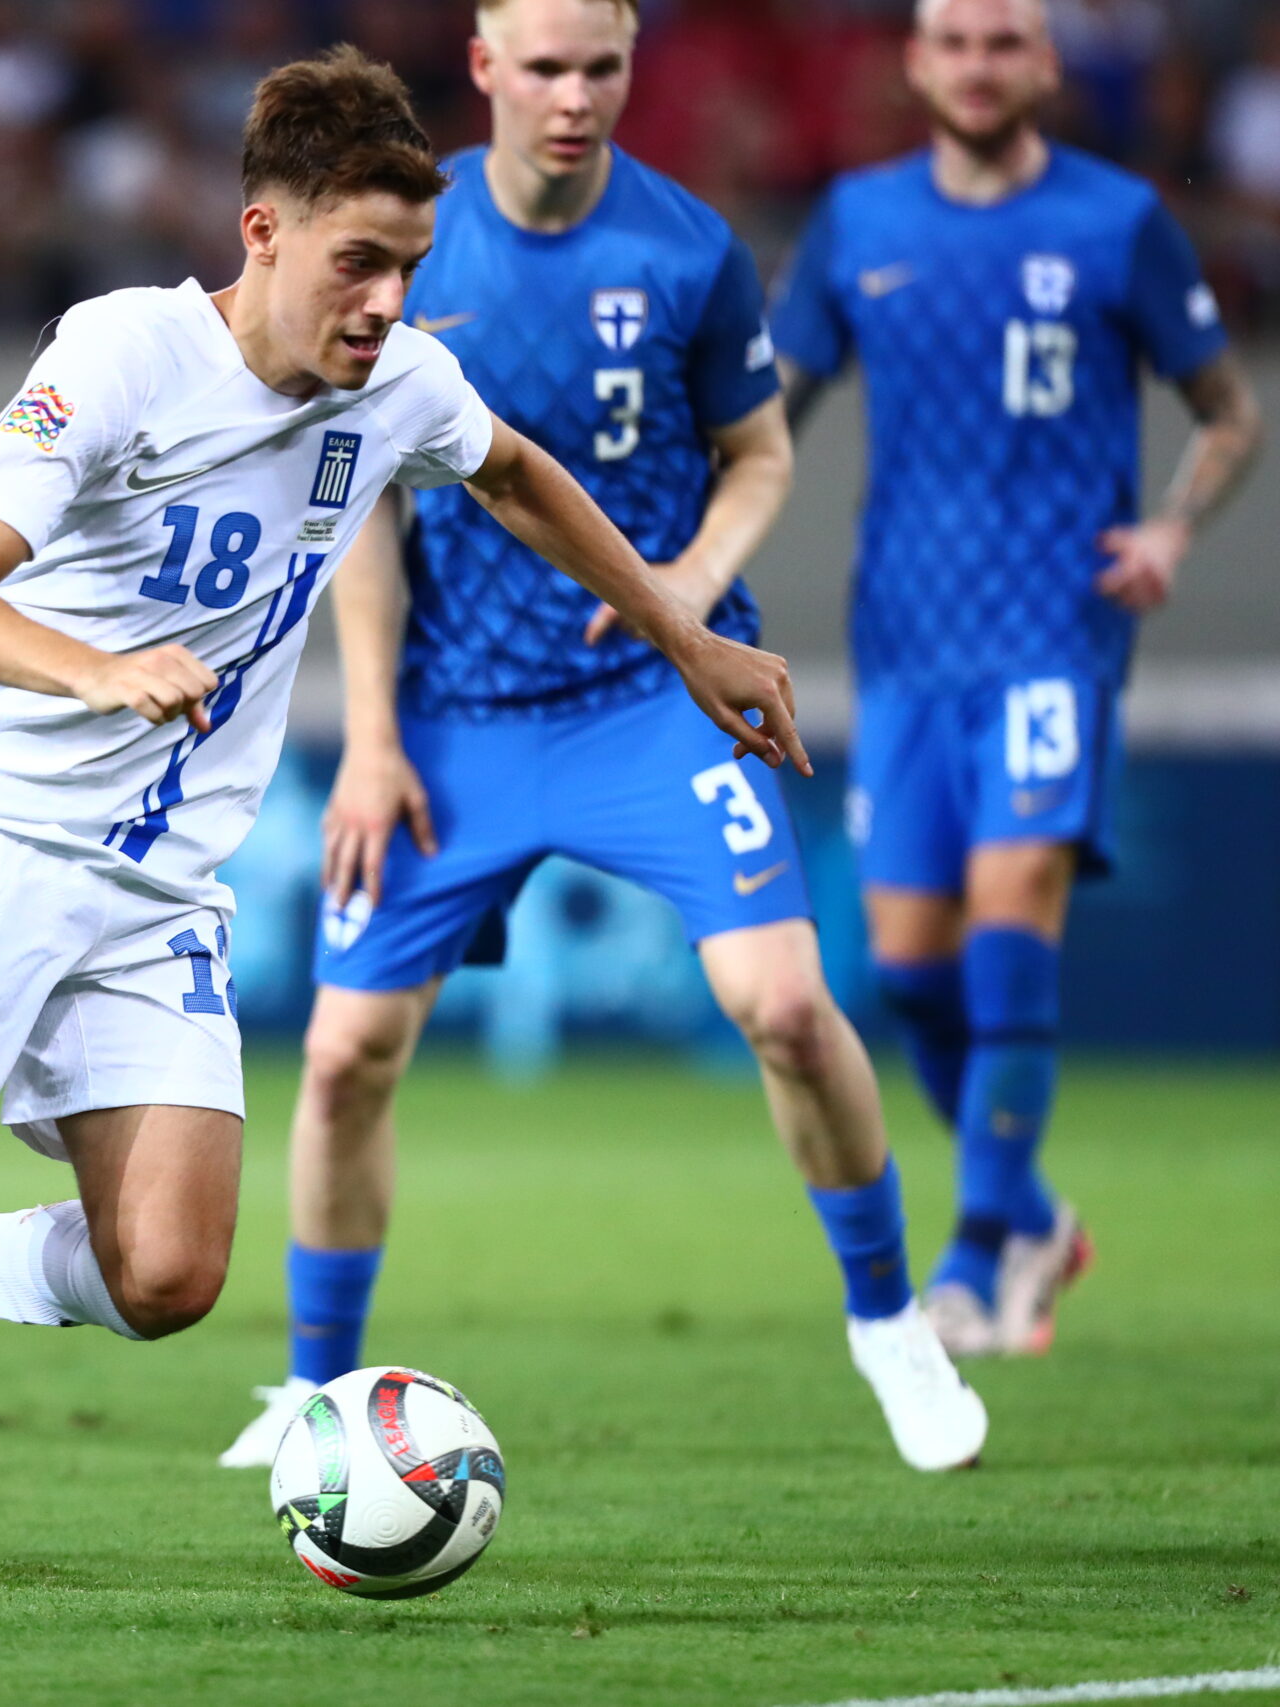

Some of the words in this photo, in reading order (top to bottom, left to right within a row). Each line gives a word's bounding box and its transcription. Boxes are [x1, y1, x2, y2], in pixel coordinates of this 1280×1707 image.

[594, 369, 644, 461] 3
[1003, 318, 1077, 418] 13
[328, 437, 357, 449] ΕΛΛΑΣ
[138, 504, 263, 609] 18
[1005, 680, 1079, 781] 13
[691, 761, 773, 855] 3
[376, 1387, 411, 1457] LEAGUE
